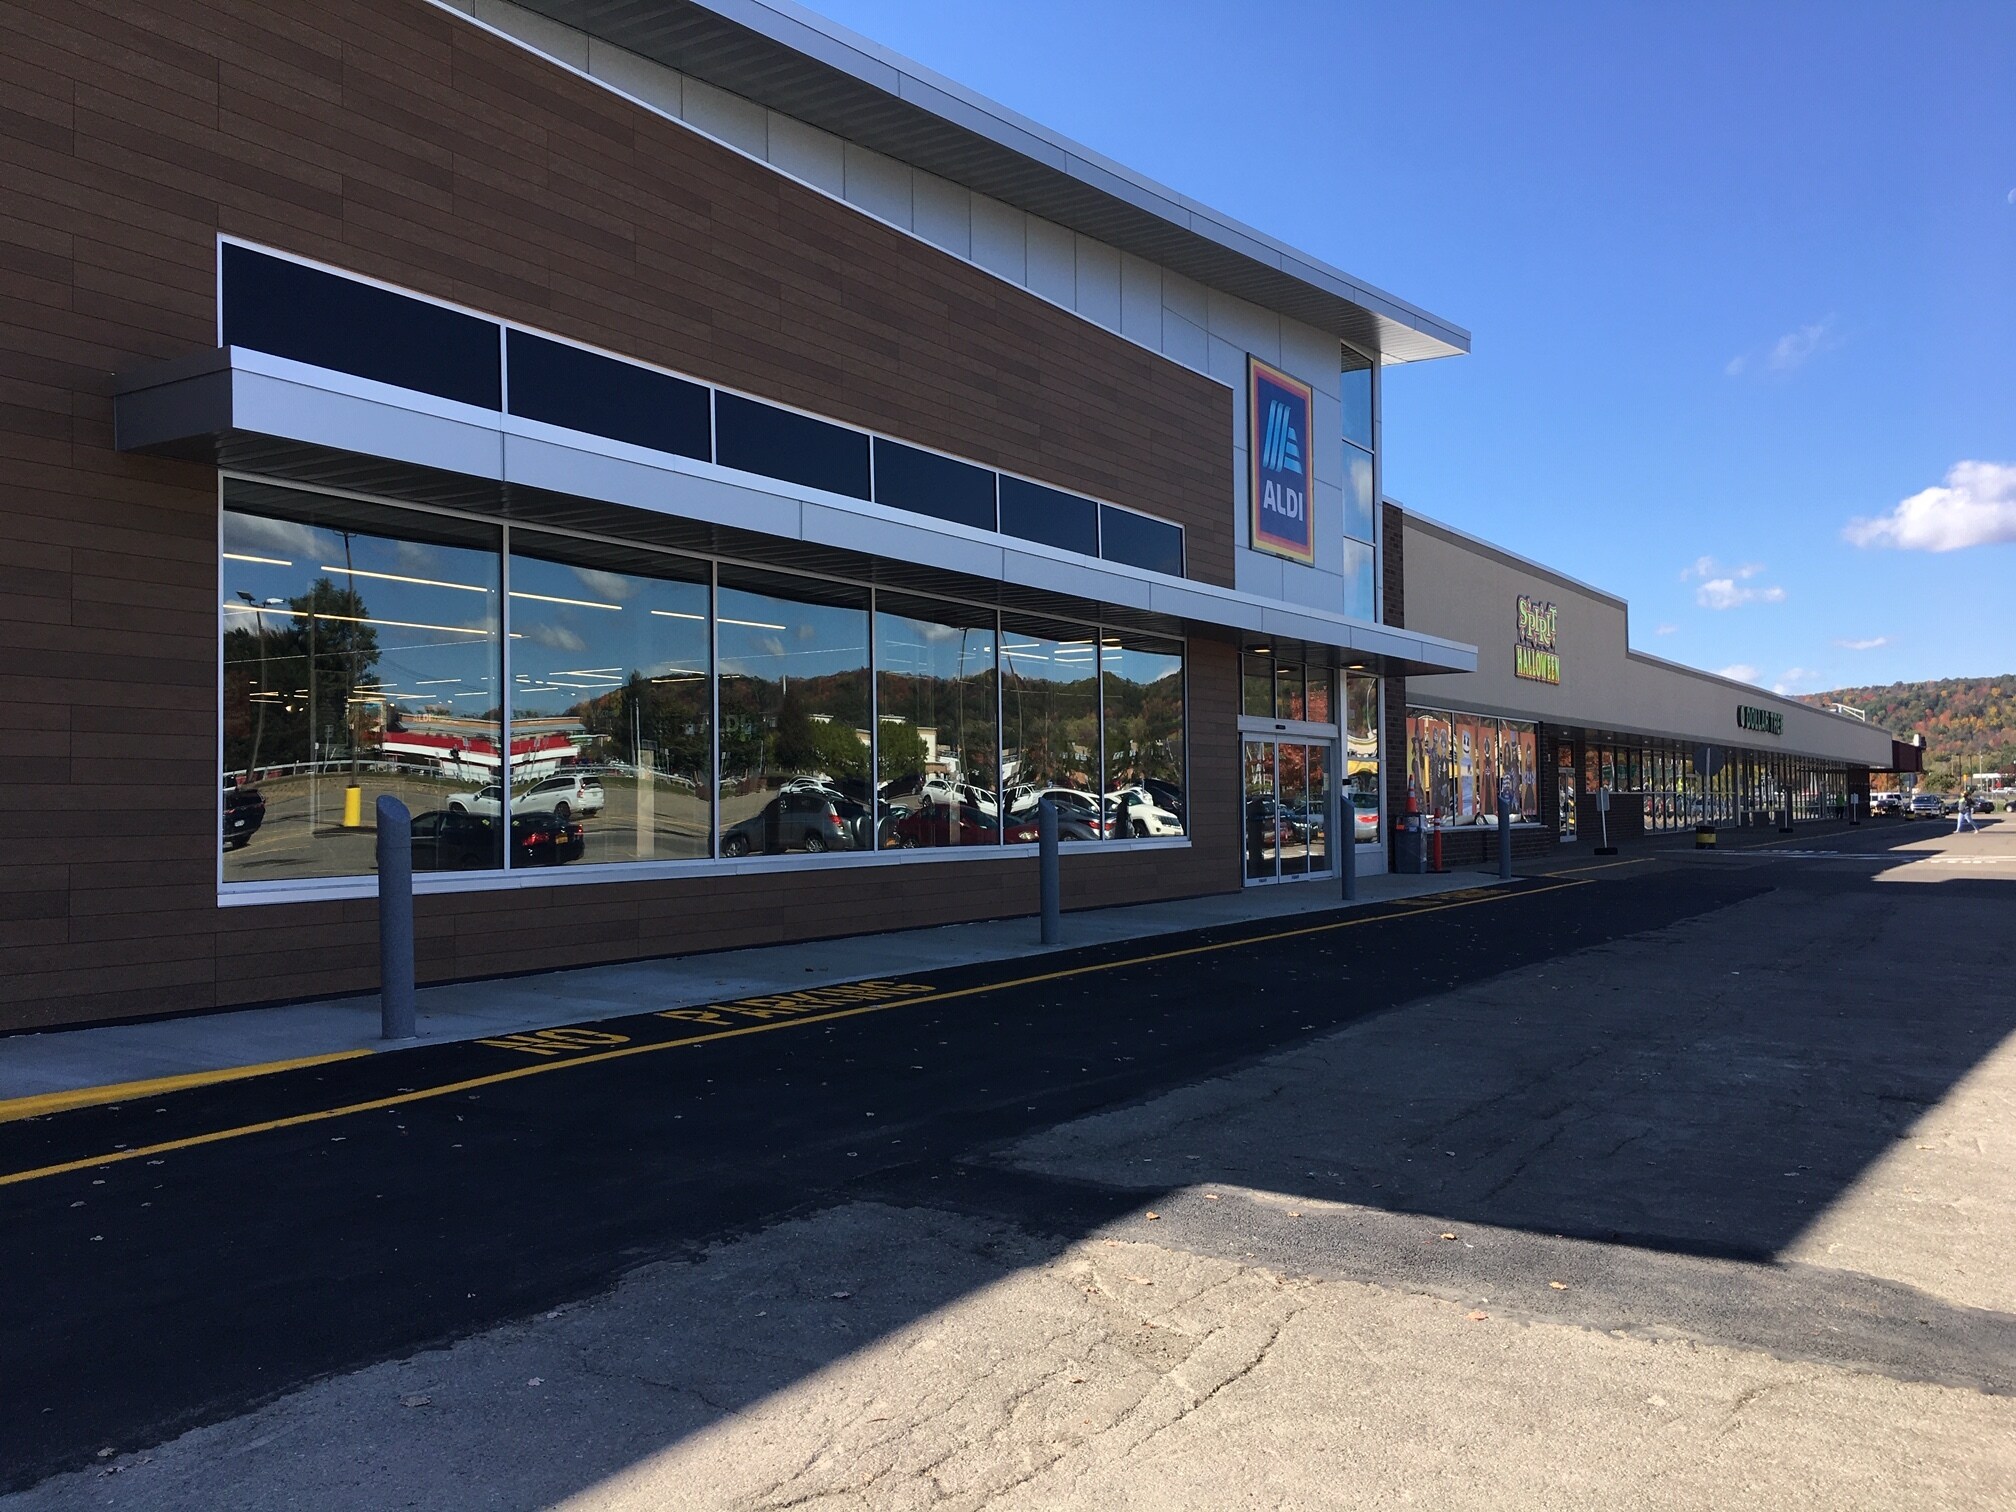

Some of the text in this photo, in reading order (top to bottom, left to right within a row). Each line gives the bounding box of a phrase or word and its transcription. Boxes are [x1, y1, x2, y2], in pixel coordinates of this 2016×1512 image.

[1263, 480, 1303, 521] ALDI
[1519, 599, 1557, 646] SPIRIT
[1517, 647, 1560, 681] HALLOWEEN
[475, 980, 936, 1056] NO PARKING
